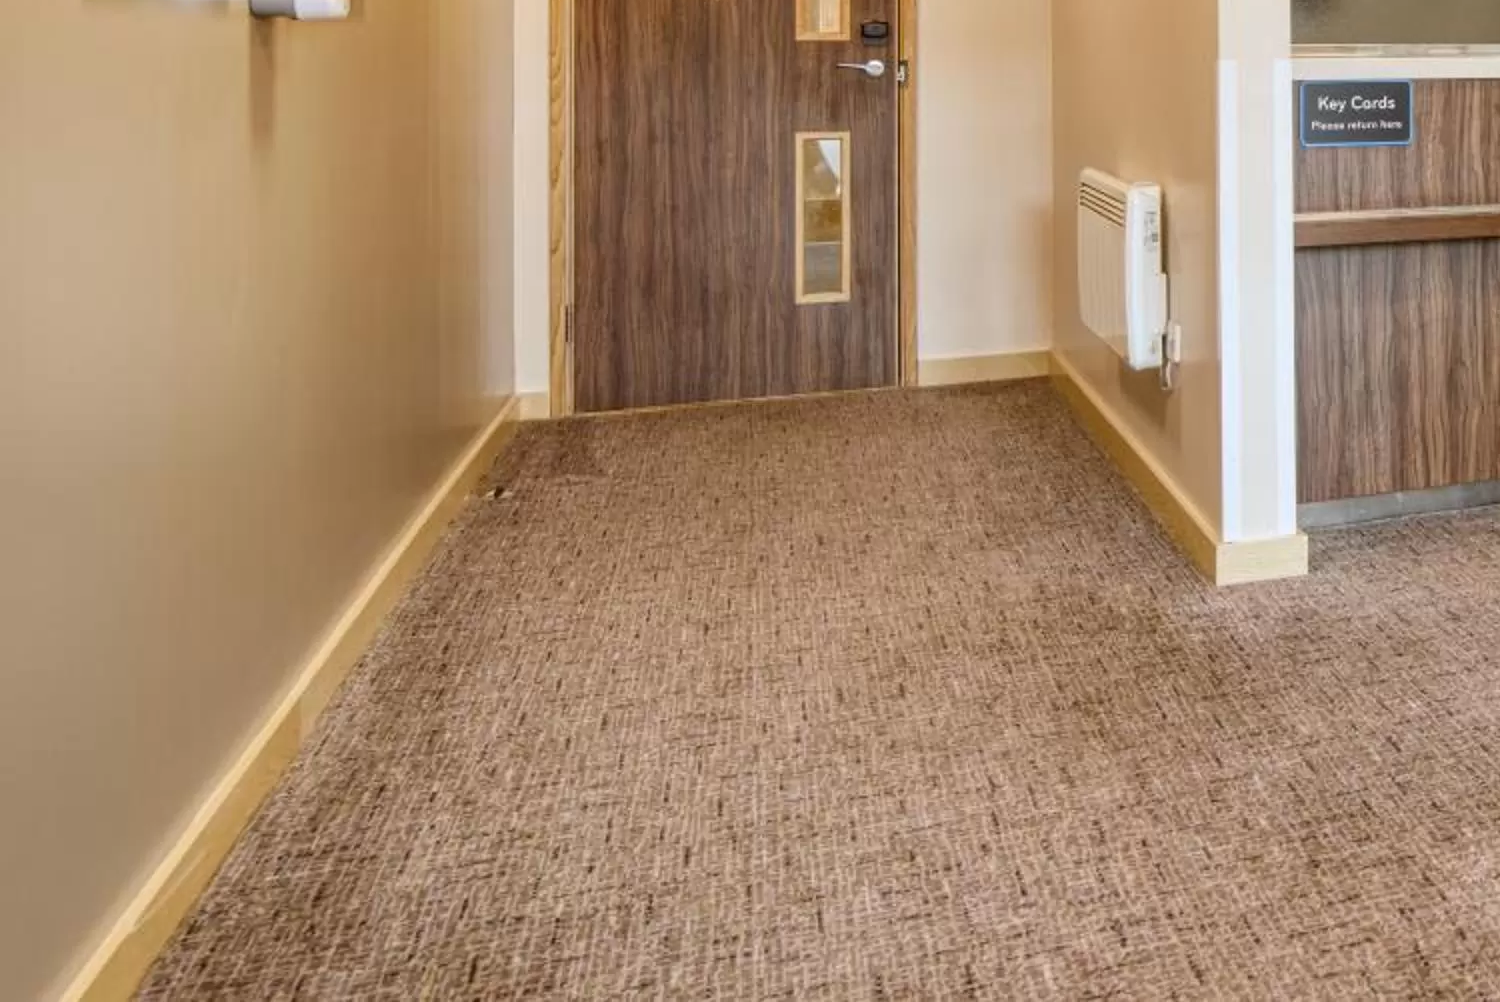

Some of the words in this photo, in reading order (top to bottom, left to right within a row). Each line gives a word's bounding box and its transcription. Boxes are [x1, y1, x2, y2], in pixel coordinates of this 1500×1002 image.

[1317, 95, 1347, 114] Key
[1351, 94, 1397, 110] Cards
[1311, 120, 1345, 131] Please
[1347, 120, 1378, 130] return
[1380, 119, 1403, 130] here
